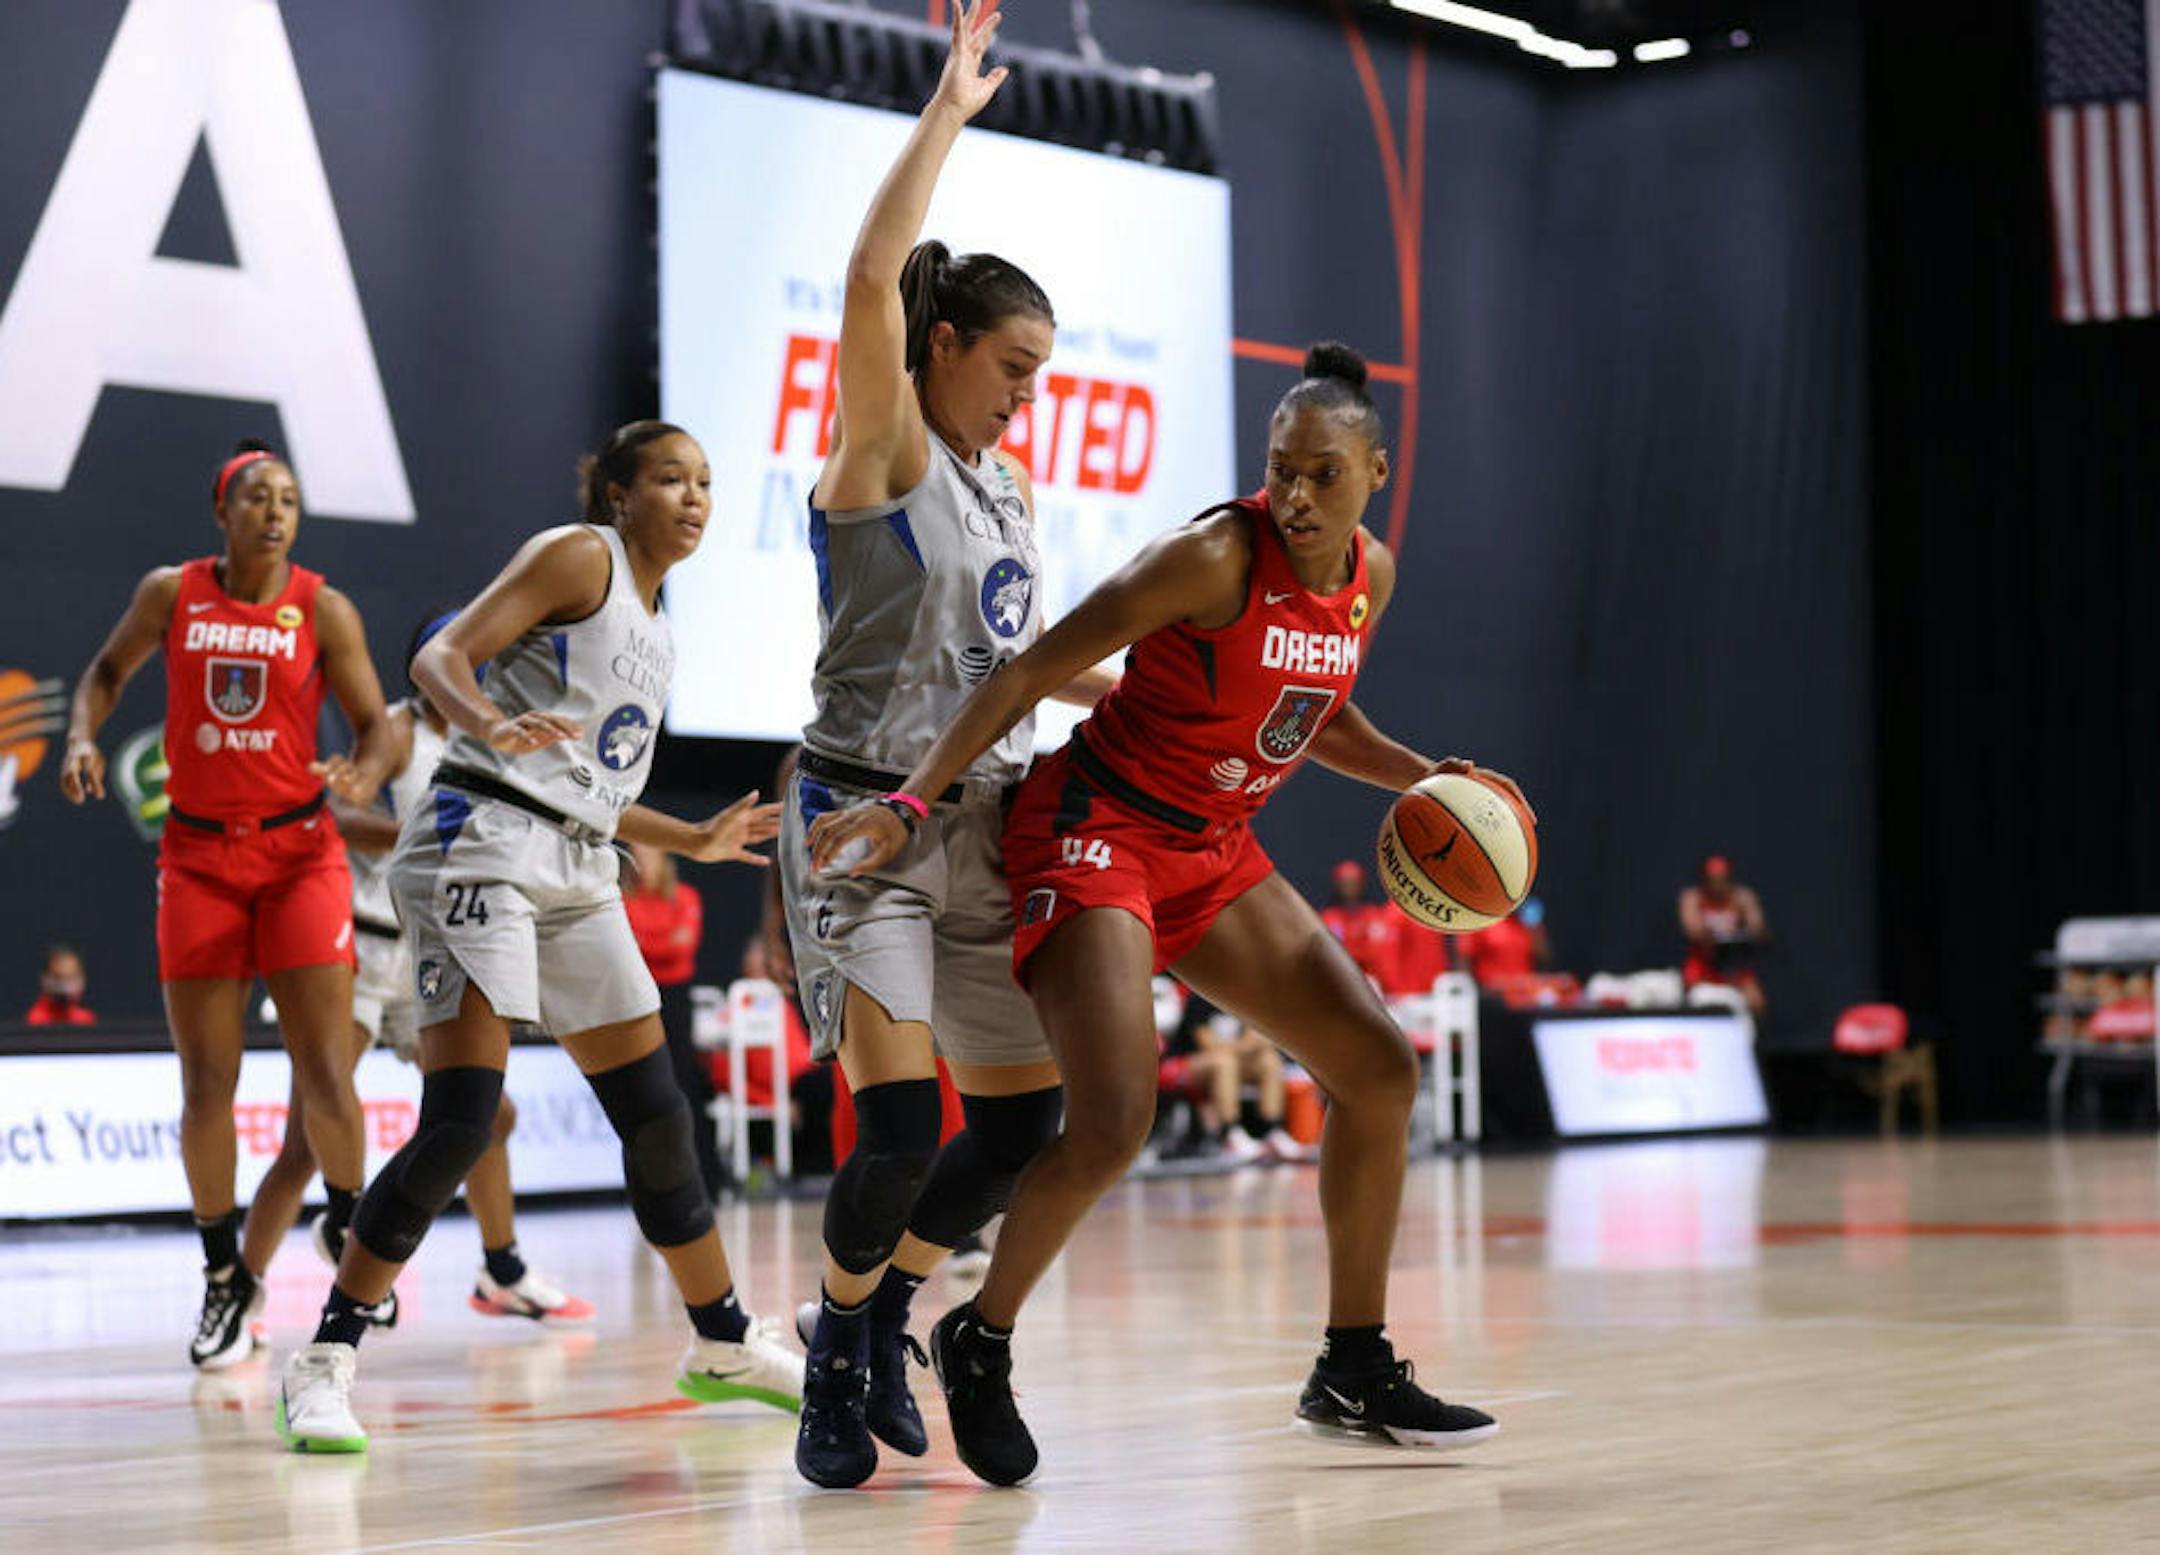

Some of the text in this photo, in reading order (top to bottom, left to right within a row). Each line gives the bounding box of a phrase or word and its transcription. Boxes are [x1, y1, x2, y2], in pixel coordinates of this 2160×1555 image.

[0, 0, 418, 524] A
[185, 620, 297, 661] DREAM
[1259, 624, 1360, 676] DREAM
[1061, 837, 1112, 870] 44
[1382, 832, 1460, 922] SPALDING
[446, 884, 489, 926] 24
